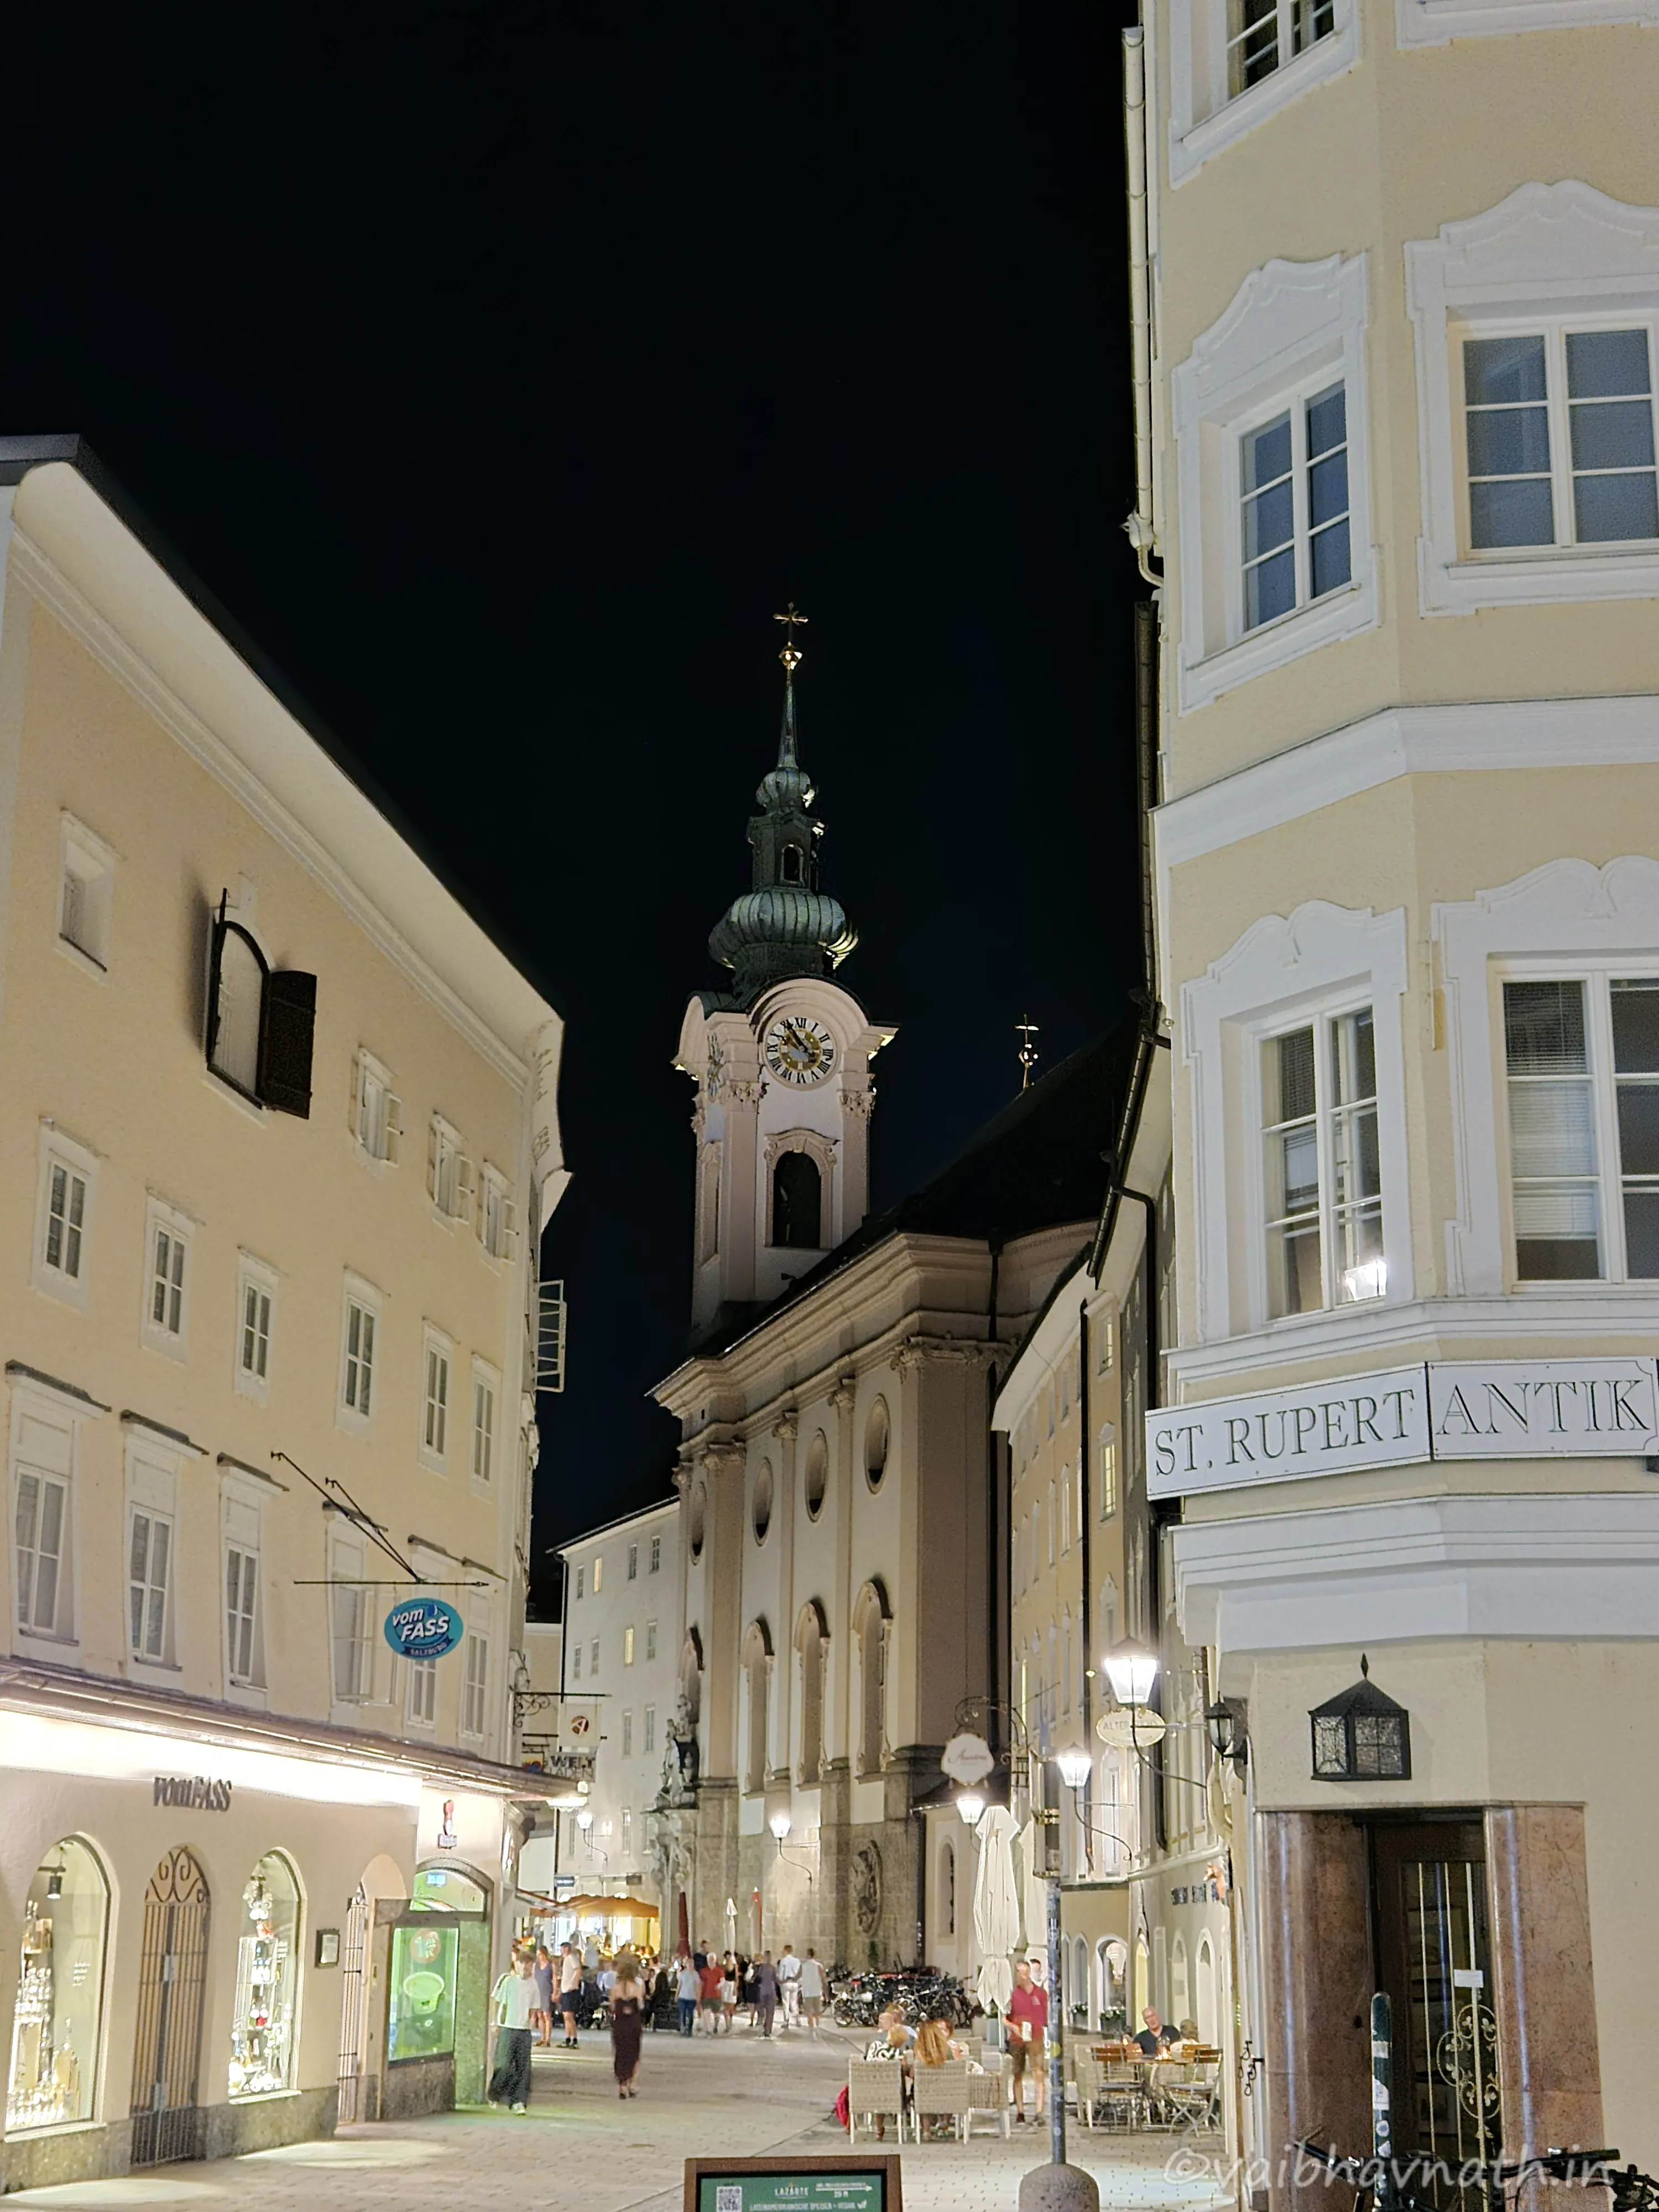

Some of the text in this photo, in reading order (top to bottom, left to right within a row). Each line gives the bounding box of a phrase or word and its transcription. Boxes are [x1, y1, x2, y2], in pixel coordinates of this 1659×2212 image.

[1155, 1380, 1651, 1476] ST. RUPERT ANTIK
[393, 1608, 424, 1626] vom
[400, 1616, 449, 1642] FASS
